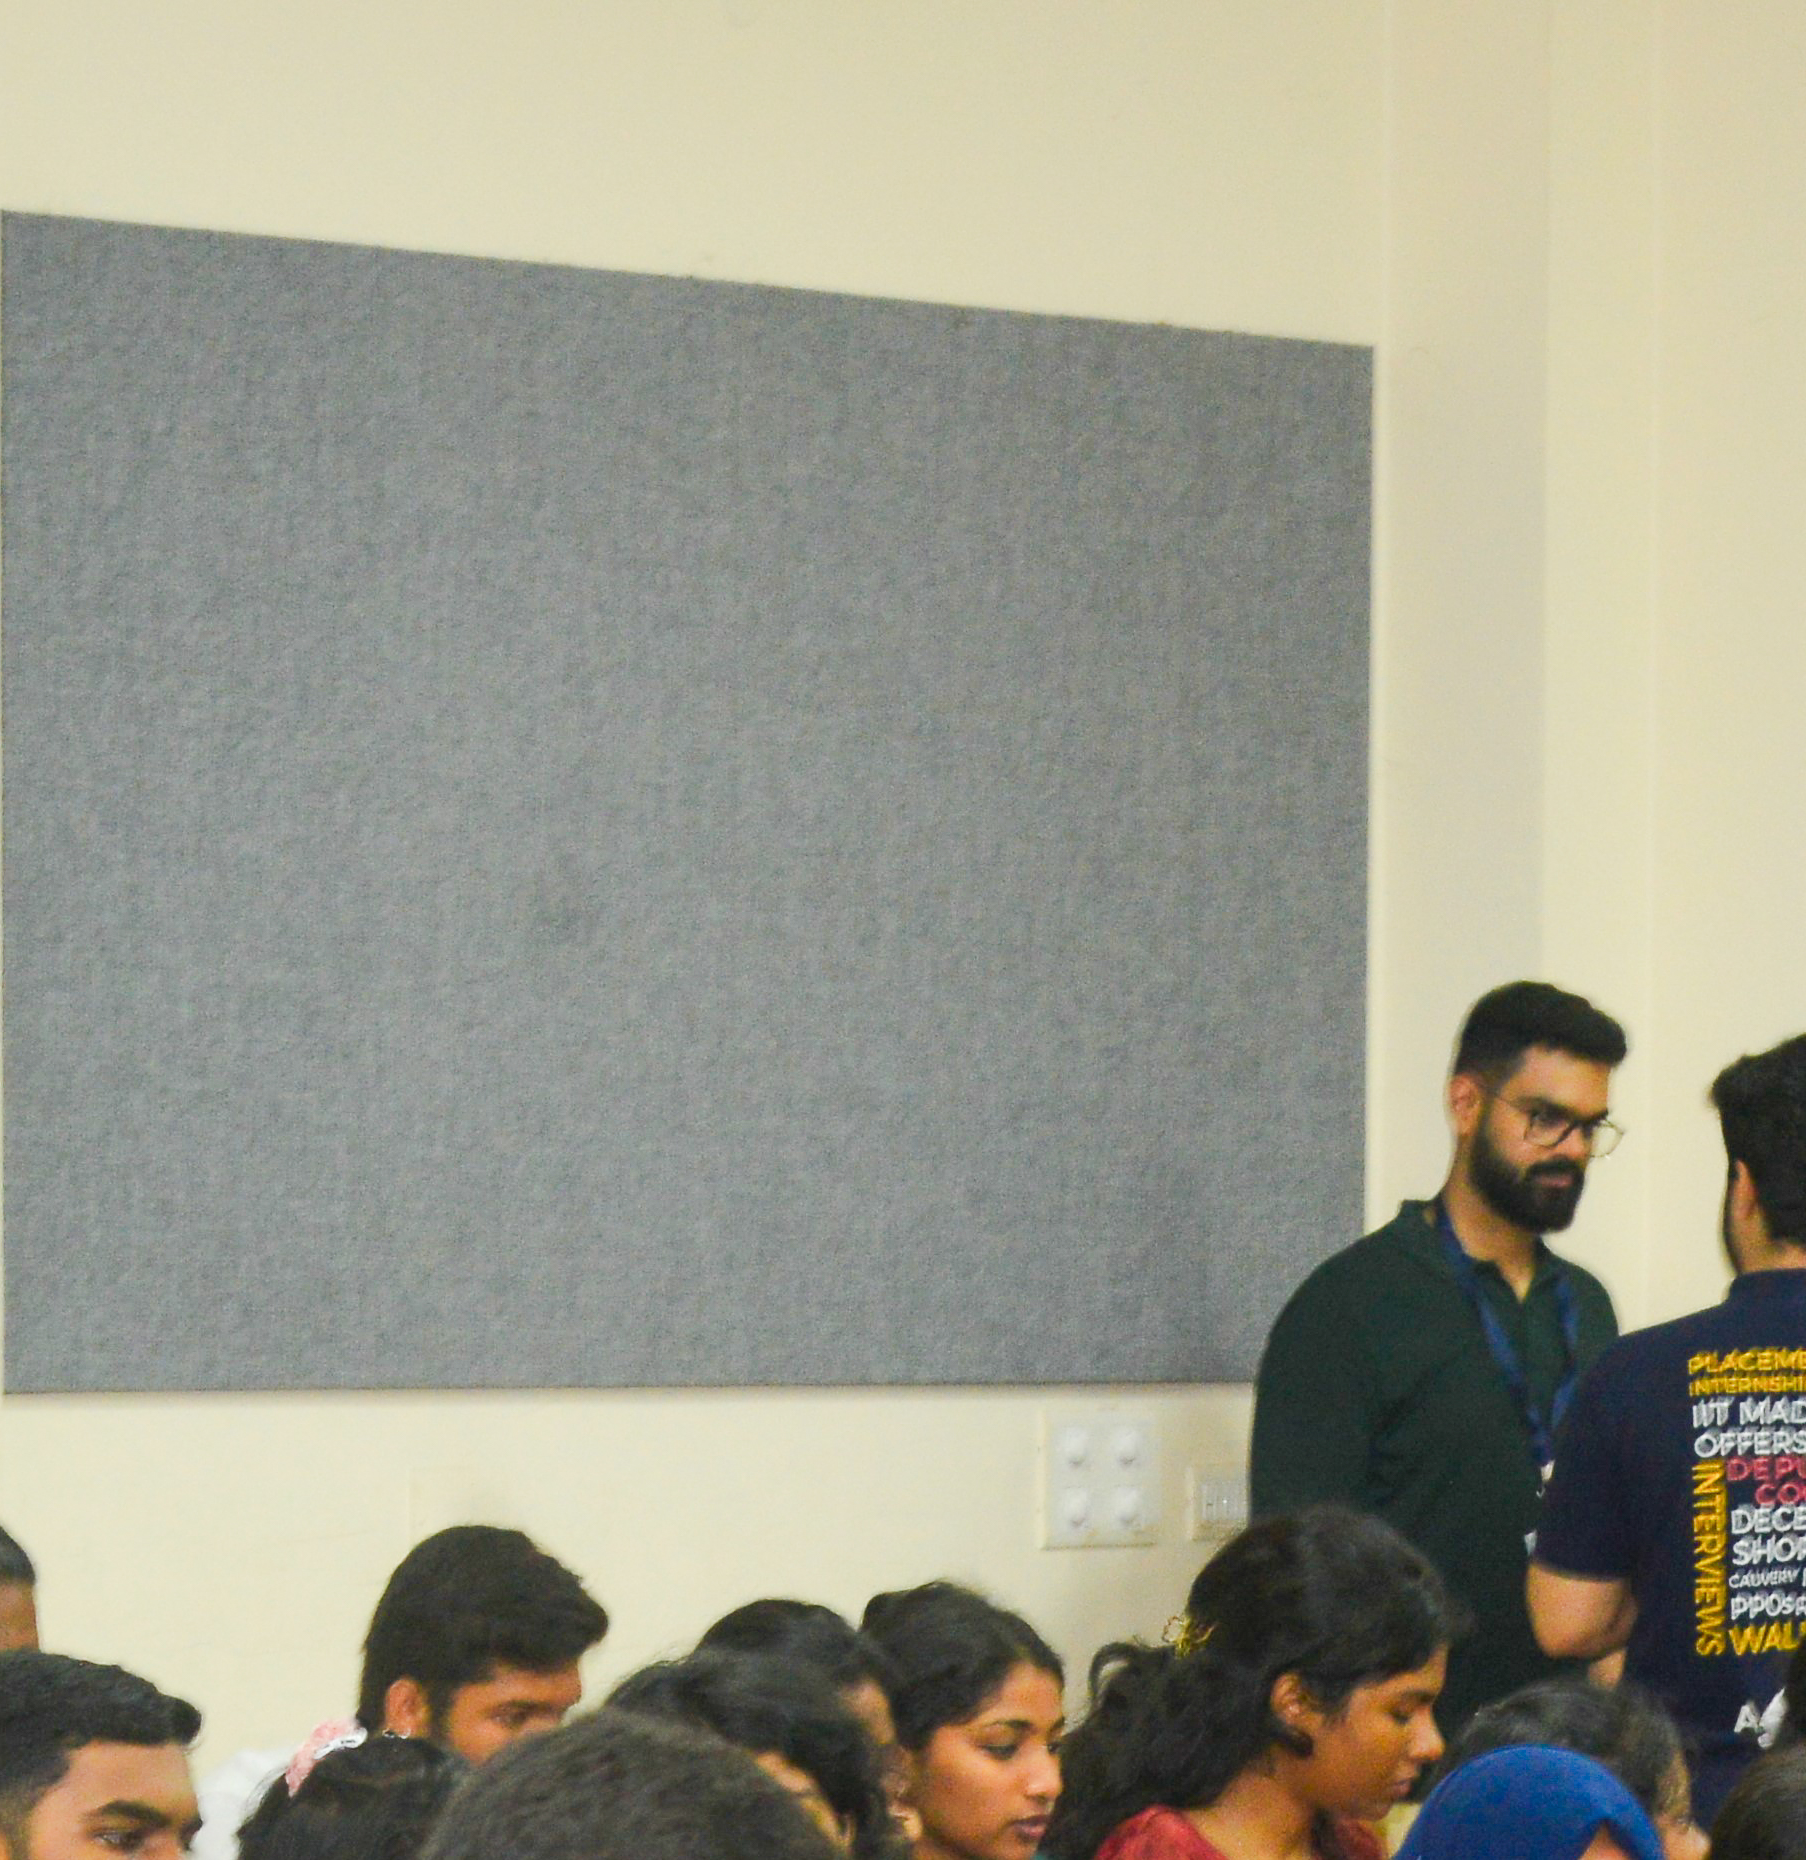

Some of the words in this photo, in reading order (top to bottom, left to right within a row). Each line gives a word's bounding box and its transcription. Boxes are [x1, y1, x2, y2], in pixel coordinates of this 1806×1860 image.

[1692, 1398, 1734, 1428] IIT
[1692, 1459, 1727, 1656] INTERVIEWS
[1728, 1565, 1800, 1589] CAUVERY
